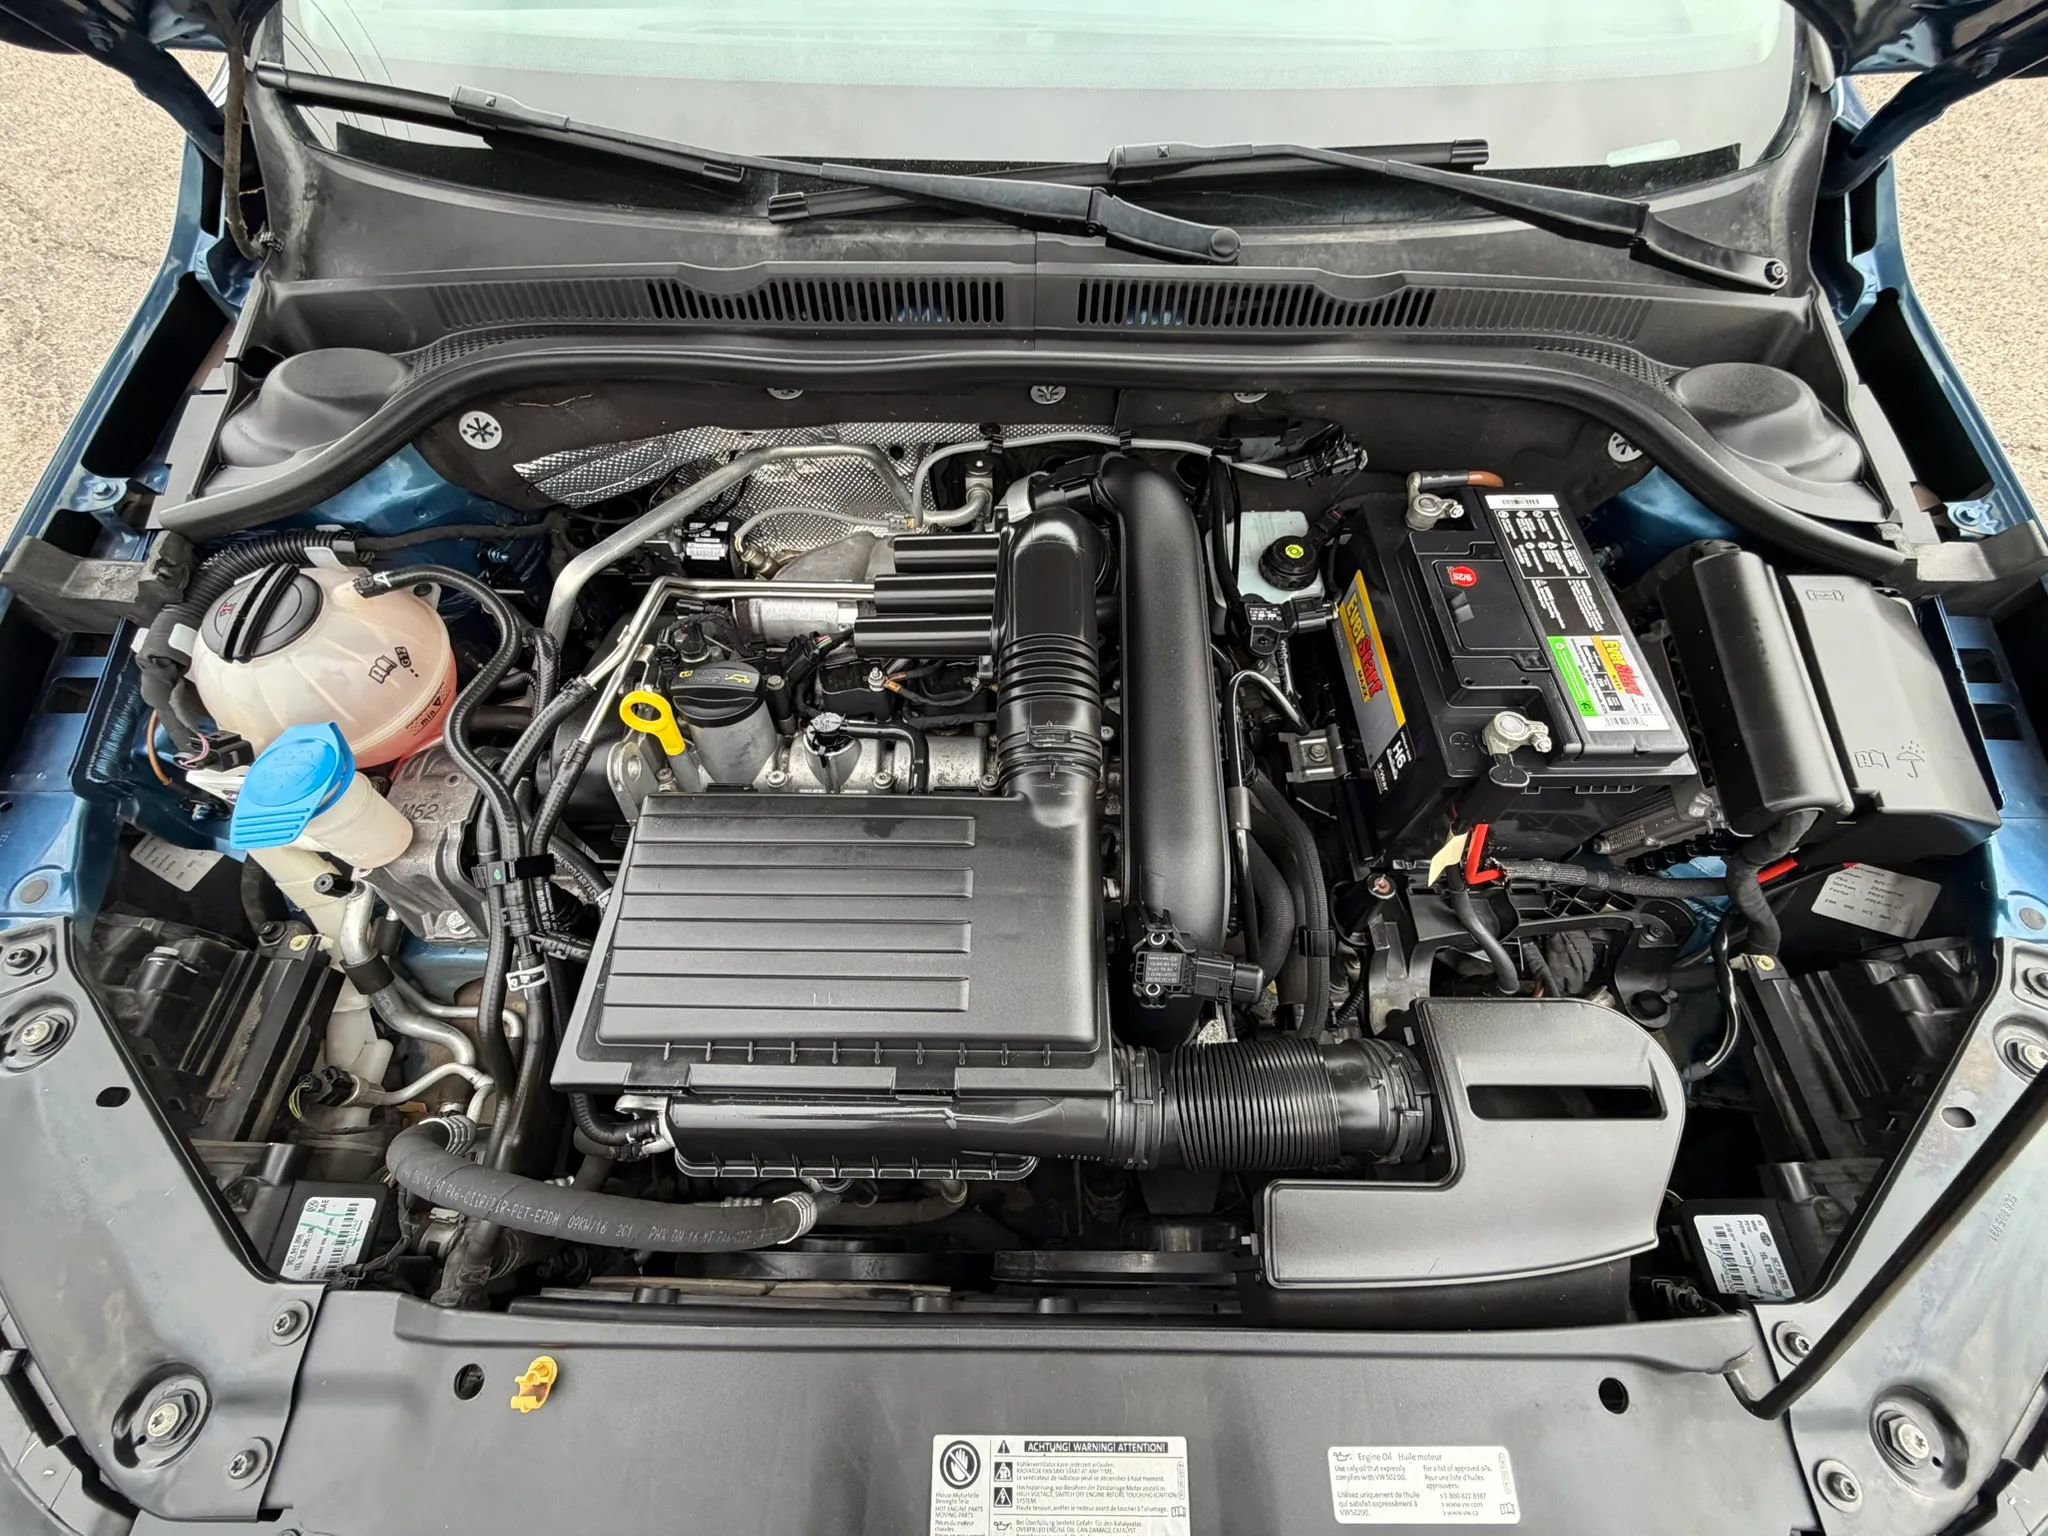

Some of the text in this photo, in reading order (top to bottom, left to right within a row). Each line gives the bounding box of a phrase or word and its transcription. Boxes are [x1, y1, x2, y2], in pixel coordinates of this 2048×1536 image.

[1345, 591, 1383, 698] EverStart
[1357, 670, 1368, 697] MAXX
[420, 710, 436, 726] min
[1392, 740, 1407, 769] H6
[318, 1200, 330, 1213] SAE
[1027, 1443, 1166, 1452] ACHTUNG! WARNING! ATTENTION!
[1358, 1453, 1380, 1463] Engine
